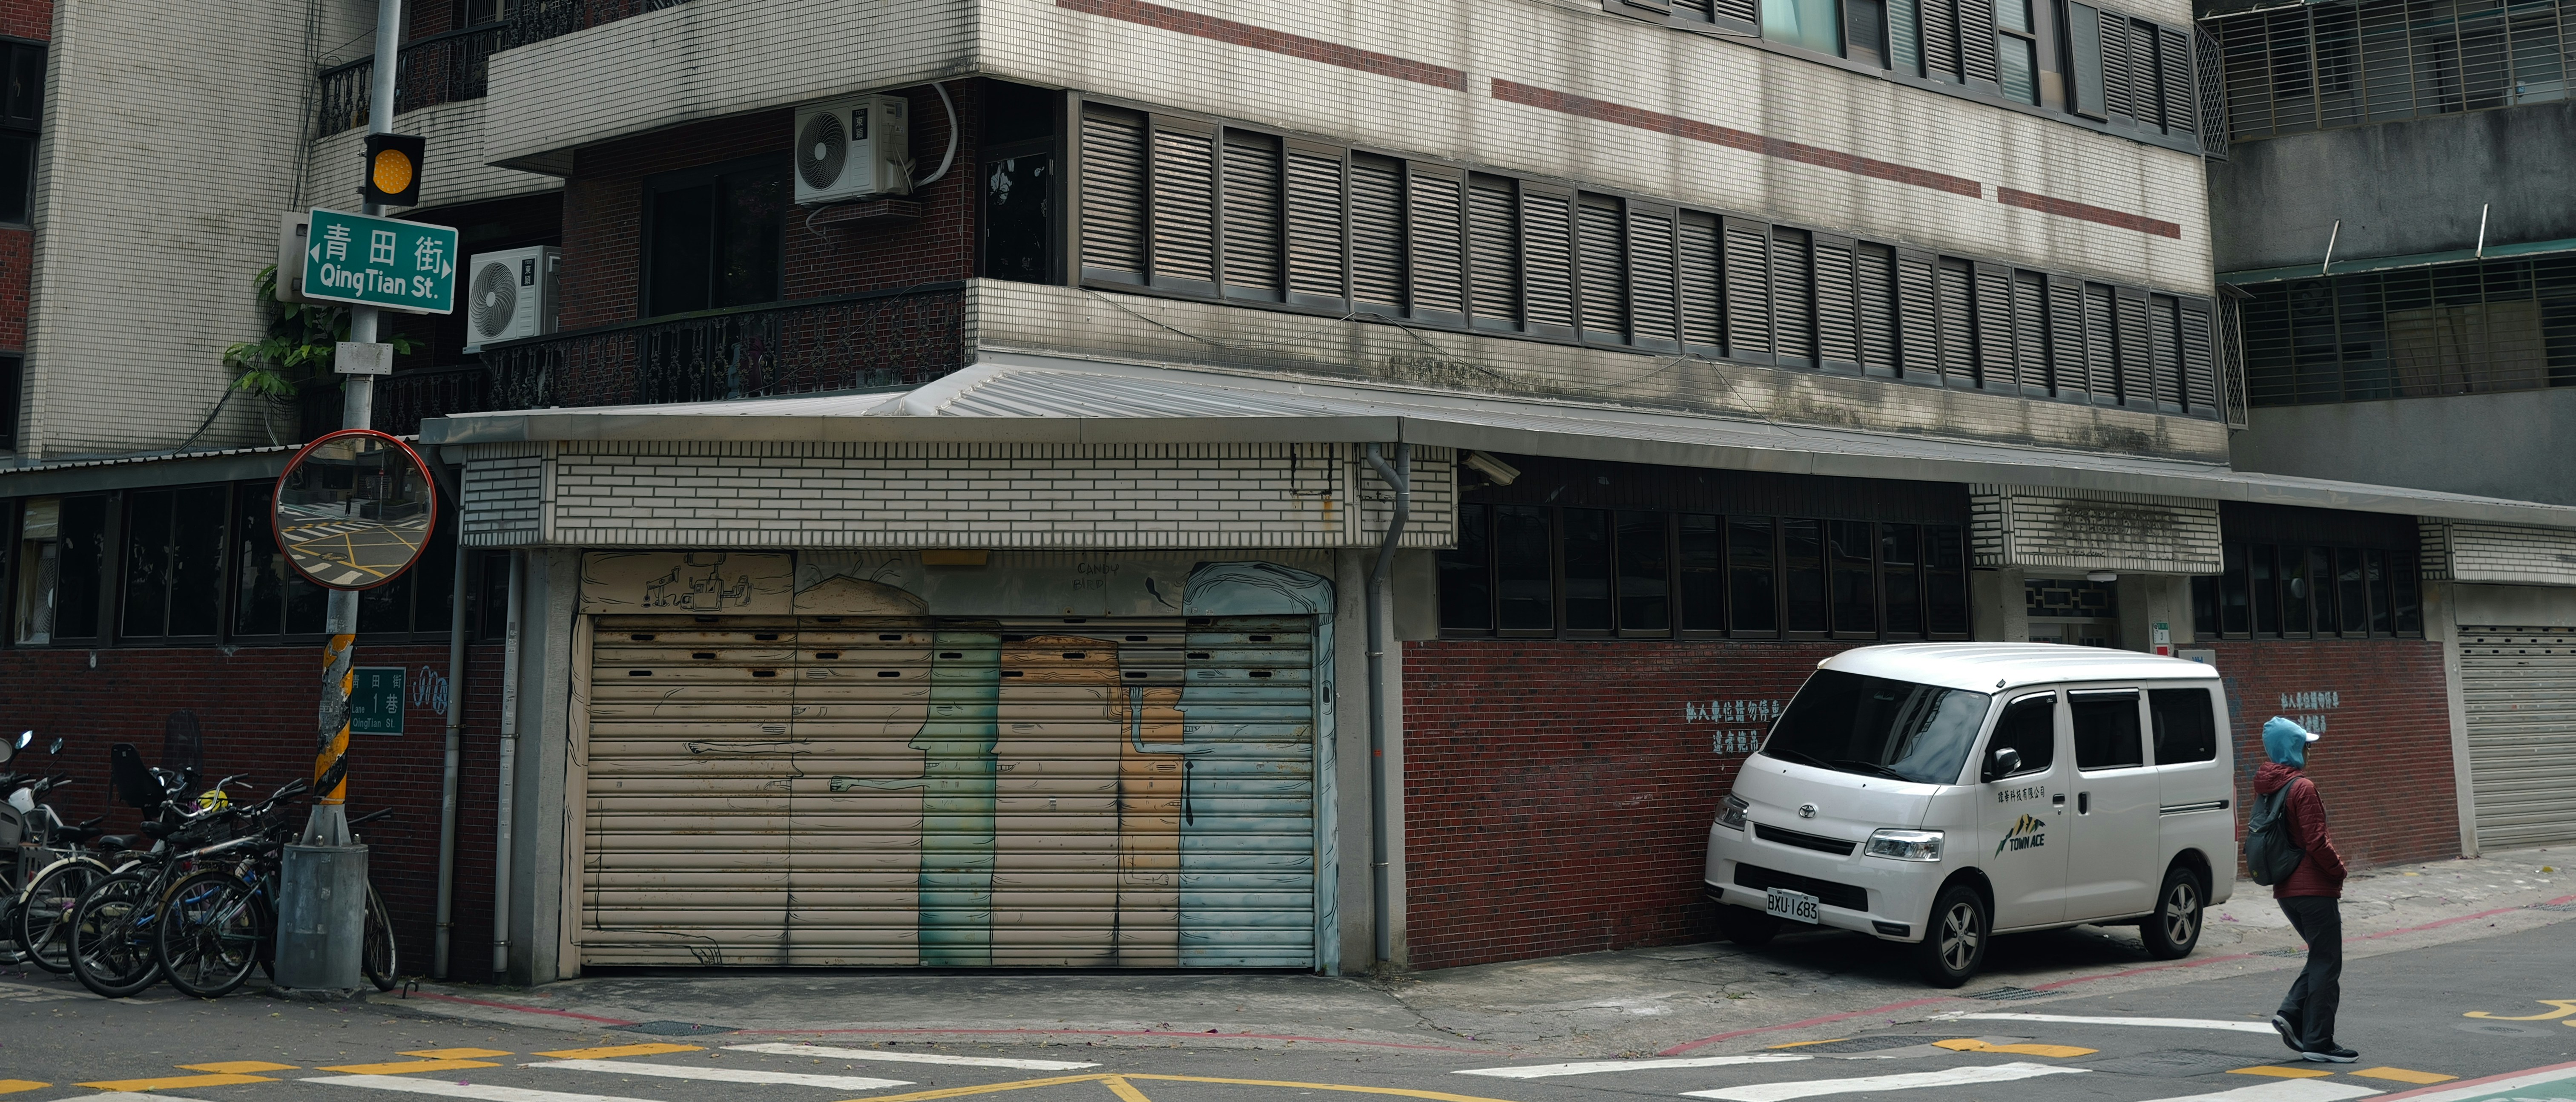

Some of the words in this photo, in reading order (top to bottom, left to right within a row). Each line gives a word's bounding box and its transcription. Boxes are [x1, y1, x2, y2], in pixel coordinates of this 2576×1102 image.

[324, 223, 443, 274] 青田街
[320, 263, 405, 297] QingTian
[411, 276, 438, 299] St.
[1077, 563, 1119, 576] CANDY
[1072, 577, 1103, 591] BIRD
[352, 674, 402, 688] 青田街
[352, 705, 365, 714] Lane
[353, 718, 381, 730] QingTian
[386, 718, 395, 728] St.
[2010, 836, 2030, 851] TOWN
[2030, 834, 2045, 848] ACE
